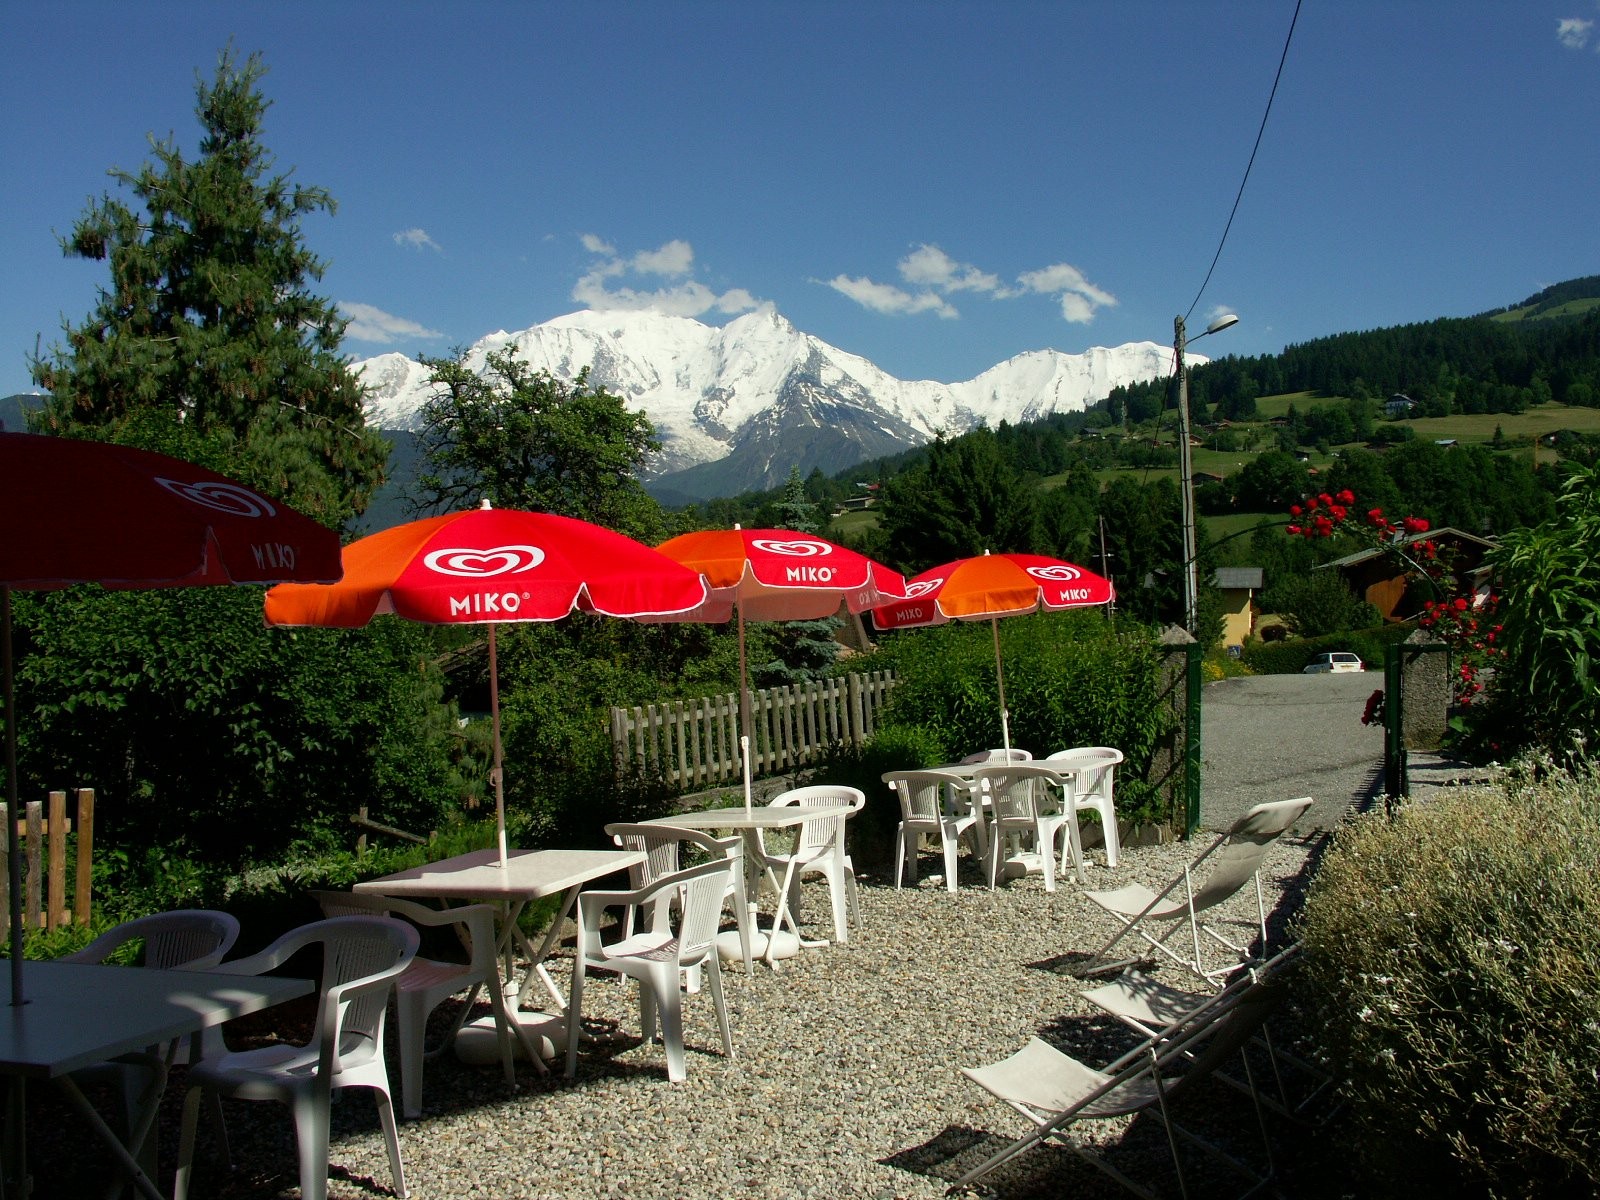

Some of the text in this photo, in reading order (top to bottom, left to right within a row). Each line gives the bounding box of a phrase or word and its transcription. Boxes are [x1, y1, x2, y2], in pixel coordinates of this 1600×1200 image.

[786, 566, 832, 582] MIKO
[1060, 588, 1088, 601] MIKO
[449, 592, 520, 616] MIKO
[896, 607, 923, 621] MIKO
